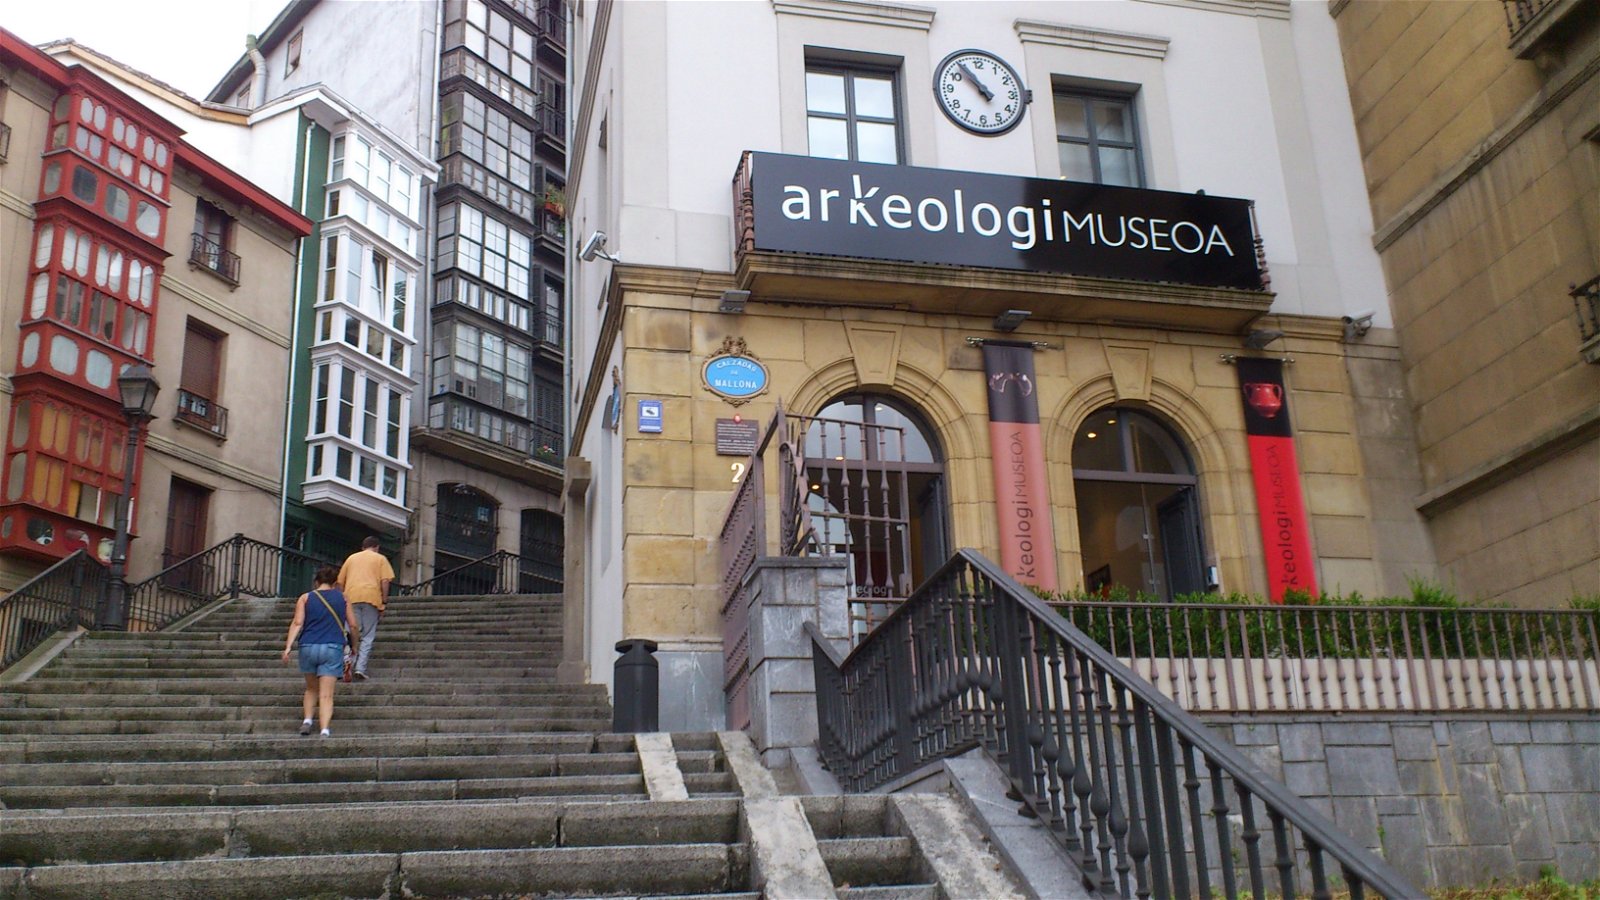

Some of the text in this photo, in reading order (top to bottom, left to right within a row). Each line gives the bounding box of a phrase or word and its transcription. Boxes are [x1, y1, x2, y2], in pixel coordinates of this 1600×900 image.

[972, 60, 984, 70] 12
[992, 66, 998, 75] 1
[950, 72, 962, 82] 10
[1002, 76, 1009, 86] 2
[947, 84, 954, 93] 9
[1008, 91, 1015, 100] 3
[952, 99, 961, 109] 8
[1004, 104, 1012, 113] 4
[963, 109, 971, 119] 7
[995, 112, 1003, 122] 5
[979, 115, 987, 125] 6
[781, 174, 1235, 257] arkeologi MUSEOA
[714, 379, 757, 389] MALLONA
[731, 462, 745, 483] 2
[1010, 431, 1035, 578] keologi MUSEOA
[1273, 510, 1299, 586] keologi
